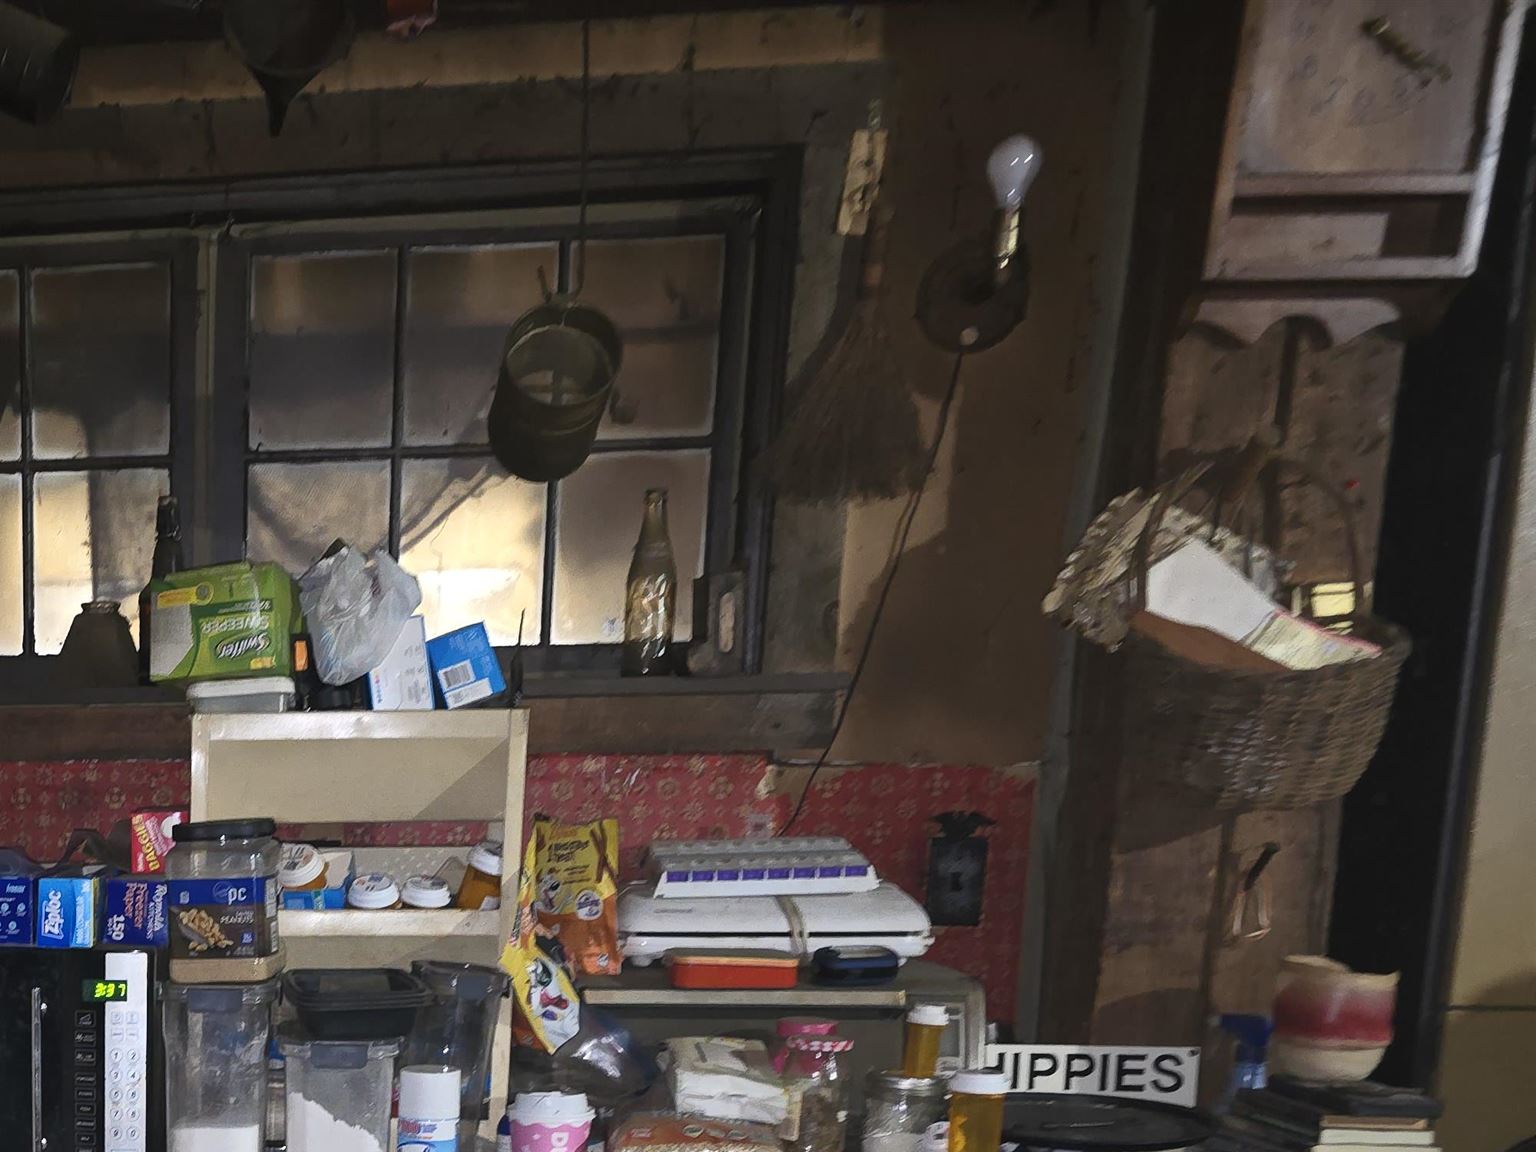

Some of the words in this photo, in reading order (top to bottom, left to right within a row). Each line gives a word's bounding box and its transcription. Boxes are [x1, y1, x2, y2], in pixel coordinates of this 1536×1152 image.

[216, 631, 268, 661] Swiffer
[45, 890, 64, 935] Ziploc
[124, 882, 138, 918] Paper
[134, 883, 147, 929] Freezer
[228, 887, 247, 905] pc
[112, 914, 125, 941] 150
